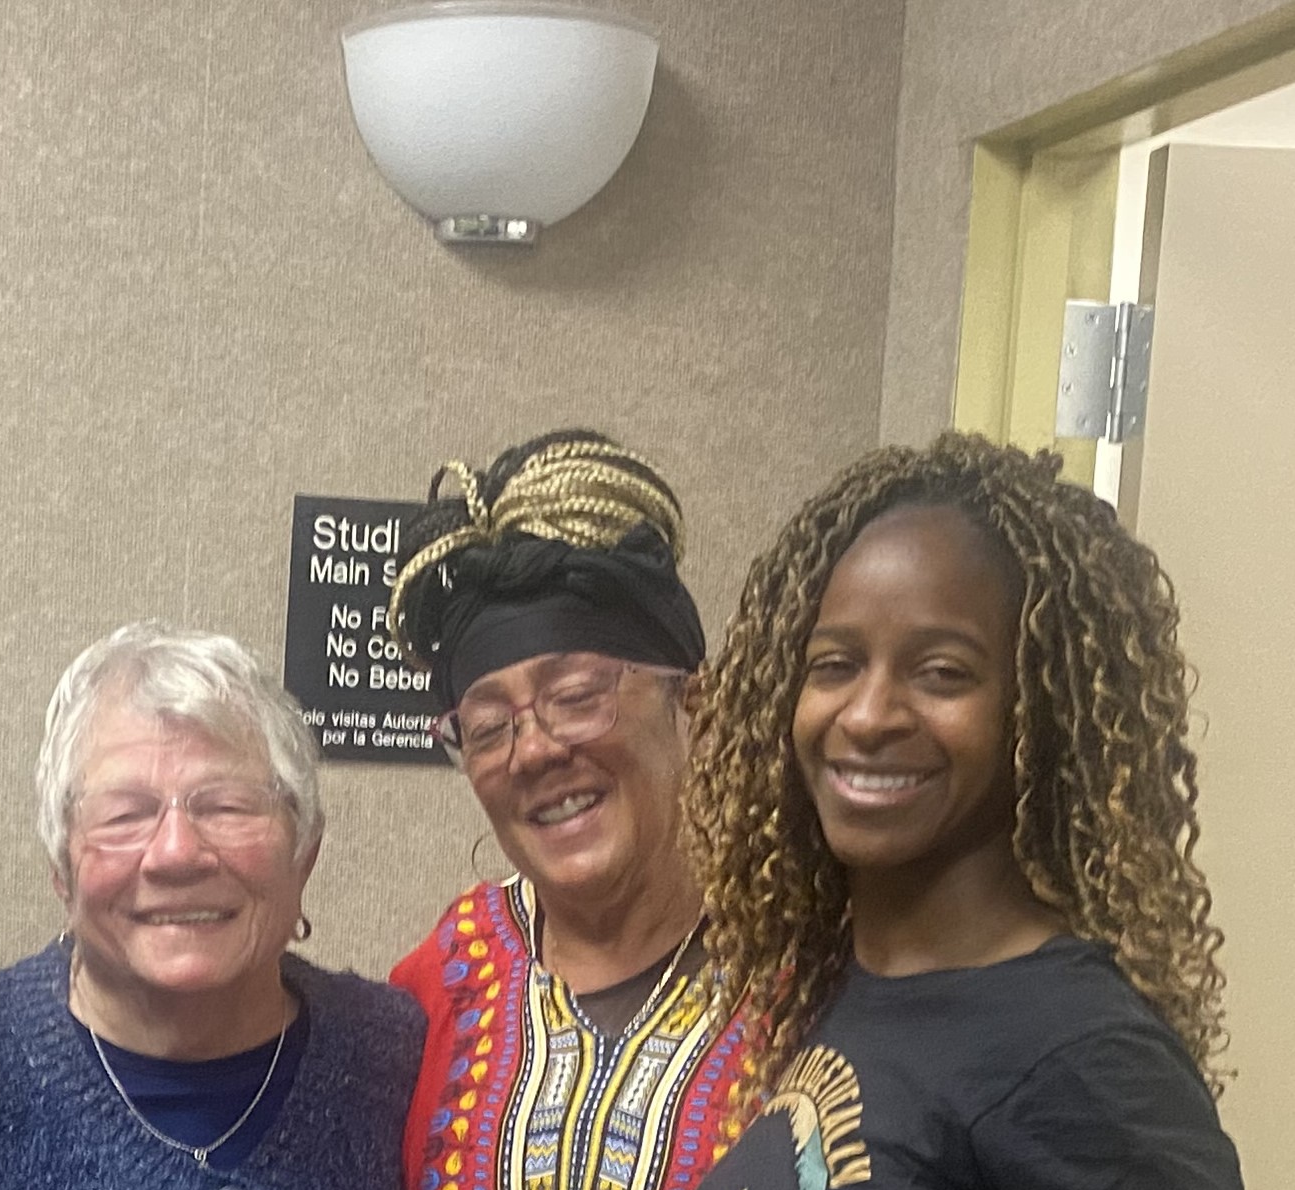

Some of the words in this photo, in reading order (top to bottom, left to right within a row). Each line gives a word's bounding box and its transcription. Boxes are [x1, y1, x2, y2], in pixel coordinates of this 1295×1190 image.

[313, 514, 400, 555] Studi
[310, 554, 370, 586] Main
[332, 604, 361, 629] No
[327, 631, 357, 658] No
[329, 662, 359, 688] No
[296, 707, 325, 726] olo
[332, 709, 376, 729] visitas
[322, 729, 346, 747] por
[354, 729, 366, 747] la
[372, 730, 433, 749] Gerencia
